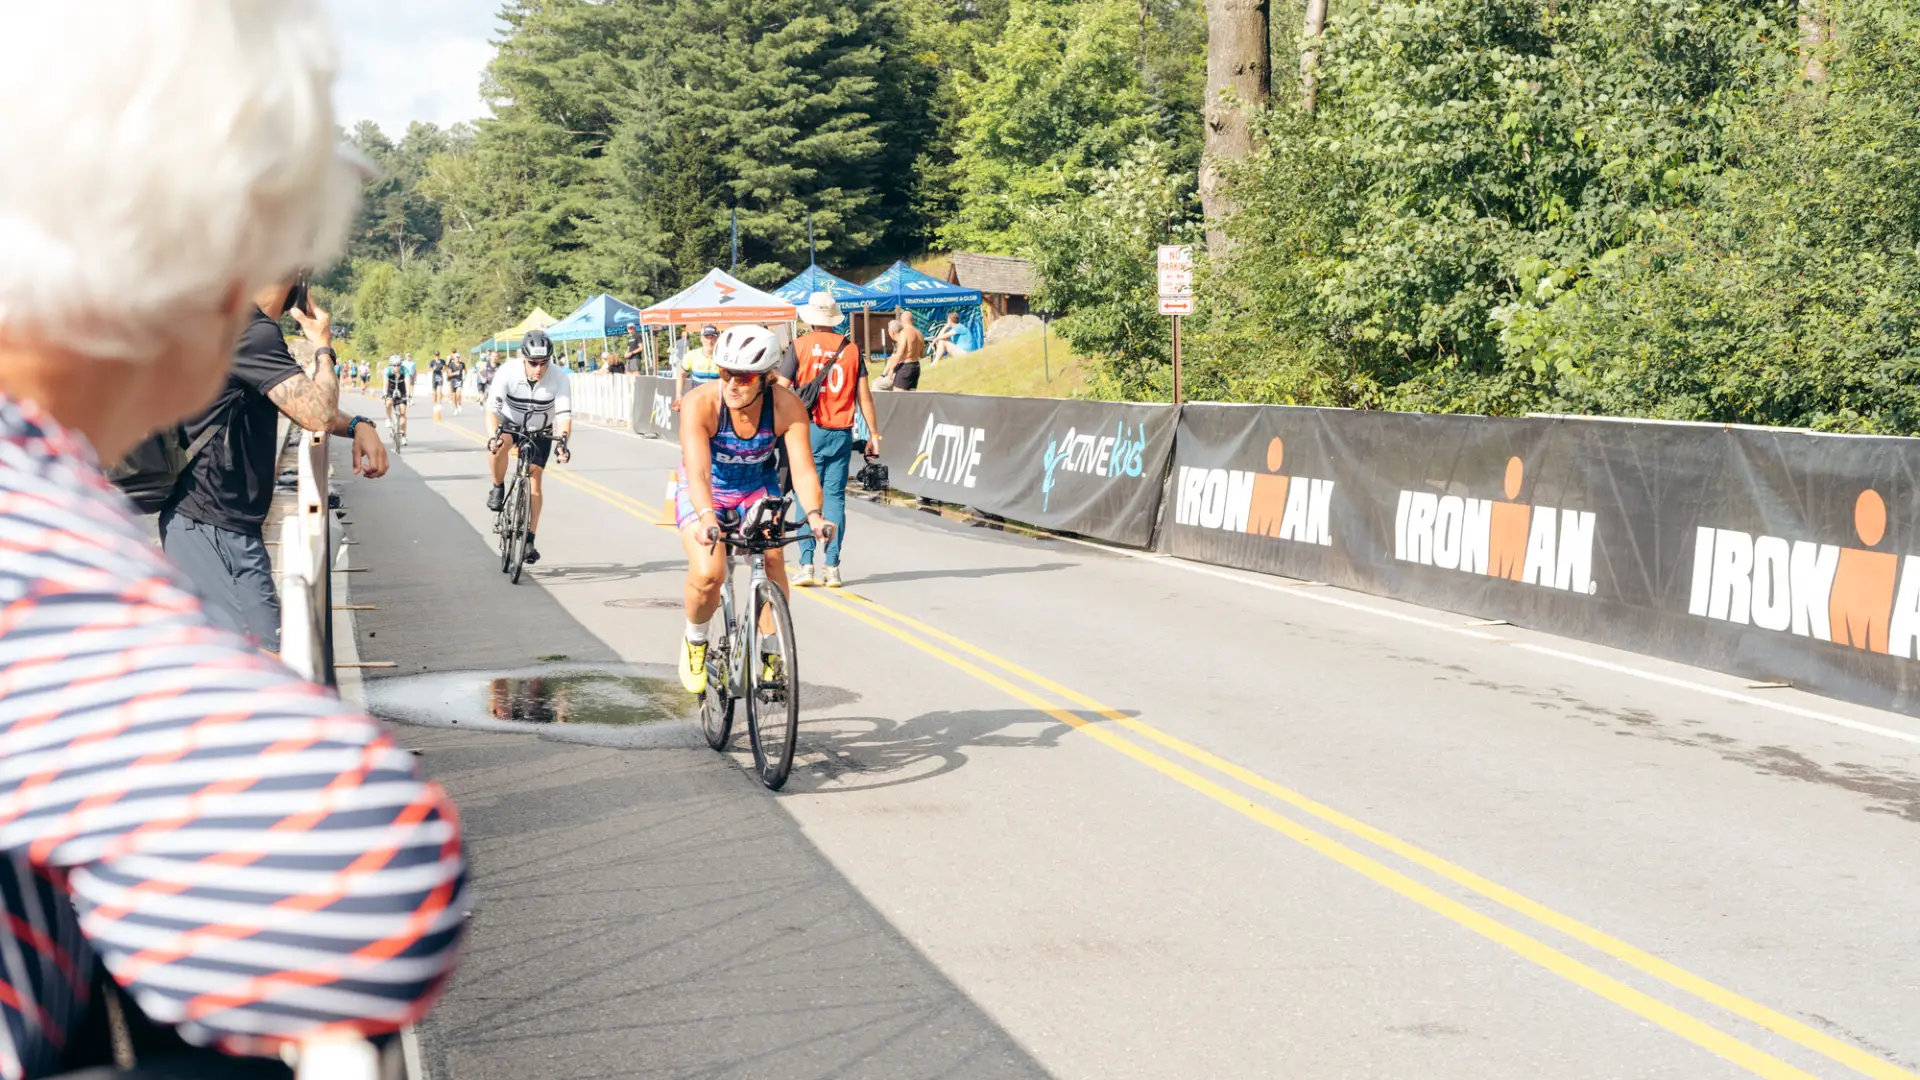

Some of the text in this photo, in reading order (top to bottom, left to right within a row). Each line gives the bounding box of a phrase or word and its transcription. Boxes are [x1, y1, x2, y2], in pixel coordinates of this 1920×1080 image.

[905, 281, 949, 290] RTA
[1168, 251, 1181, 260] NO
[908, 412, 985, 488] ACTIVE
[1175, 465, 1334, 546] IRONMAN
[1395, 489, 1597, 595] IRONMAN
